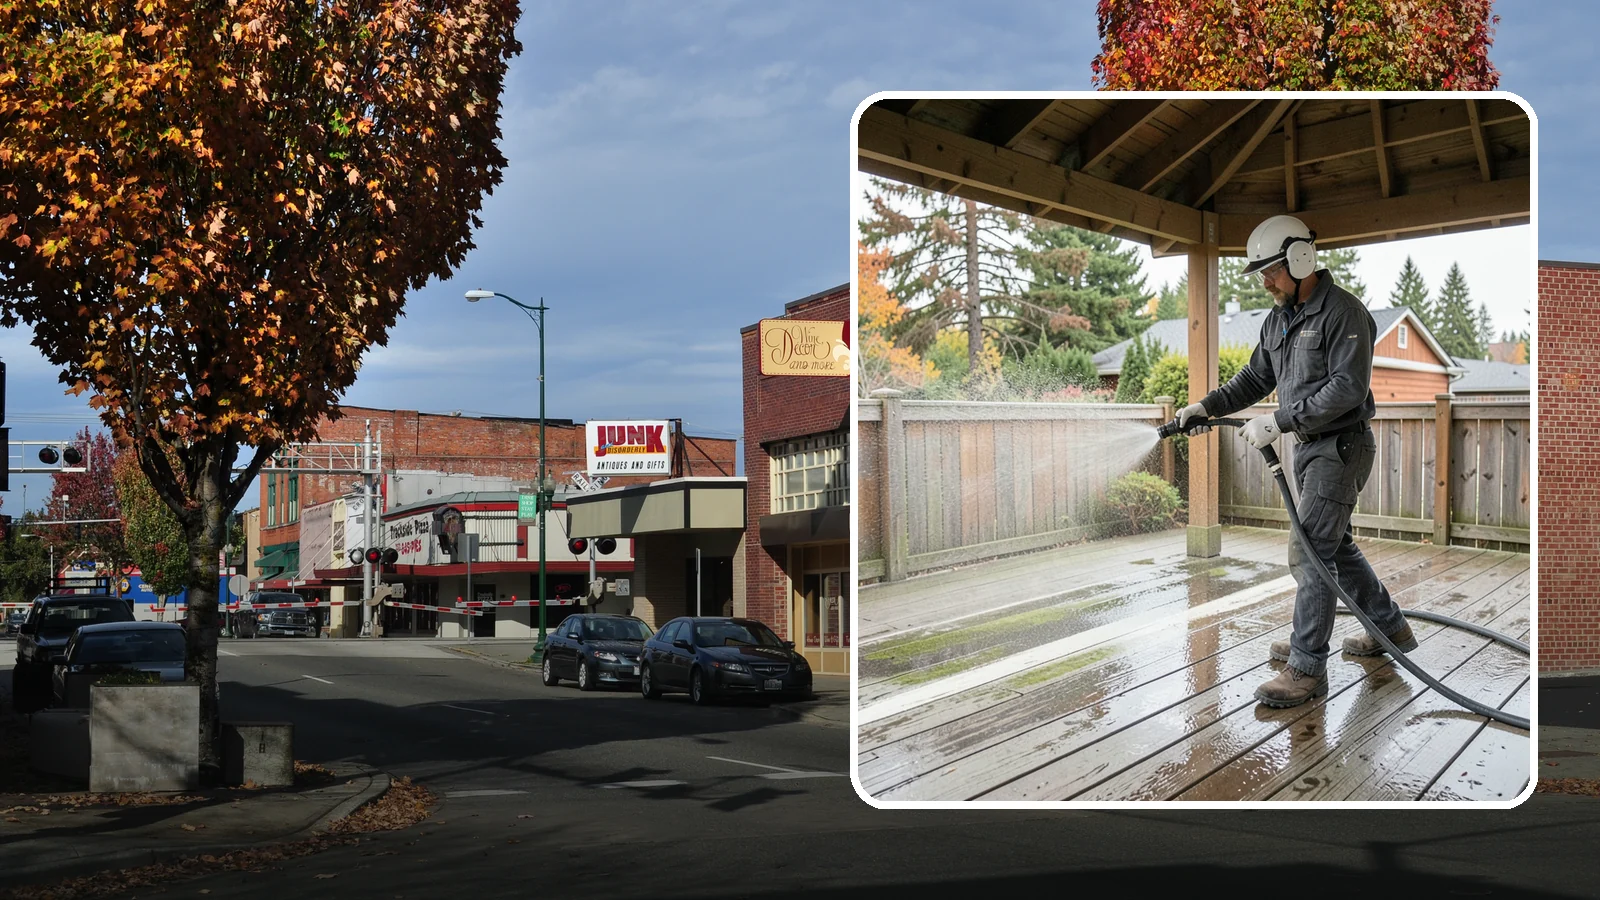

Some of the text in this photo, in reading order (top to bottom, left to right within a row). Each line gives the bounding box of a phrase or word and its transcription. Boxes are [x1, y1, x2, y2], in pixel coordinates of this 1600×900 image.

[595, 425, 665, 457] JUNK
[607, 446, 646, 454] DISORDERLY
[597, 460, 665, 470] ANTIQUES AND GIFTS
[414, 519, 429, 535] Pizza
